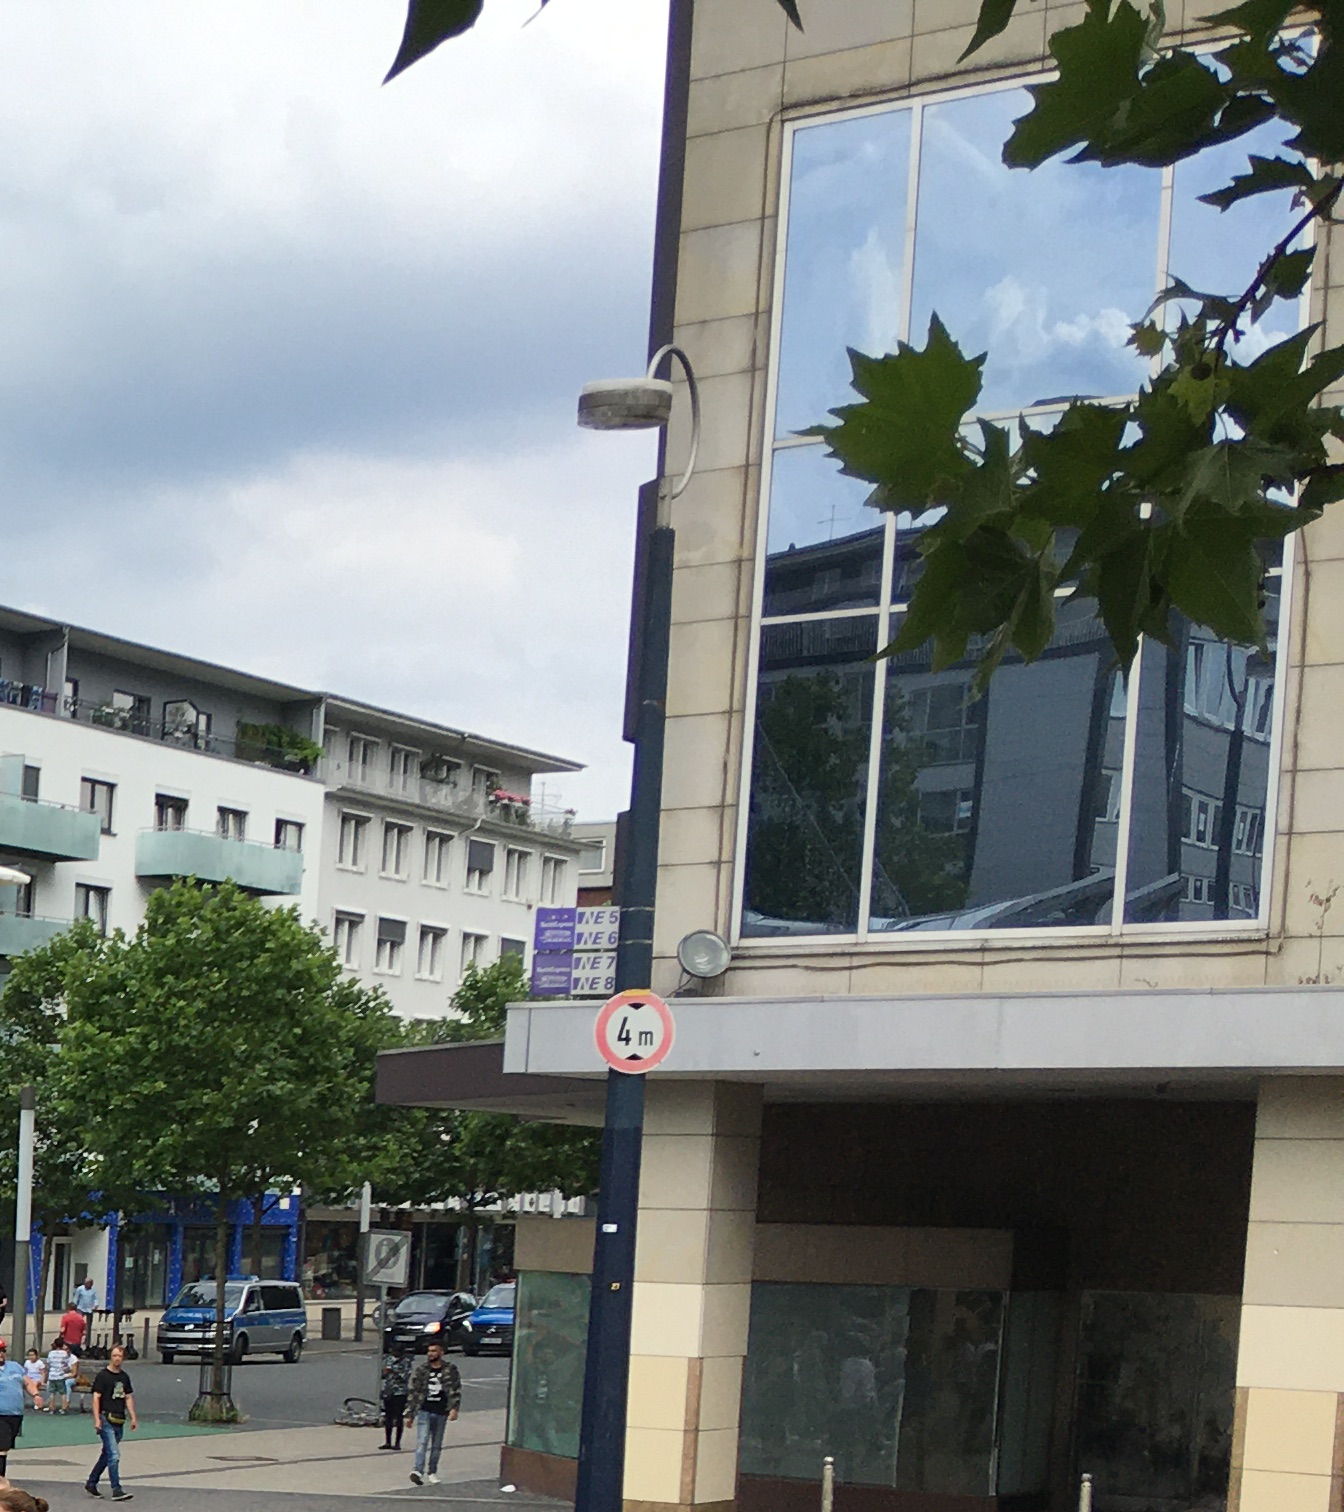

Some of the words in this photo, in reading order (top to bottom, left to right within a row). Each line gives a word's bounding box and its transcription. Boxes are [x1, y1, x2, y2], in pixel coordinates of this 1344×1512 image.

[609, 911, 619, 924] 5
[607, 931, 618, 945] 6
[606, 956, 616, 970] 7
[603, 976, 615, 990] 8
[617, 1016, 632, 1046] 4
[638, 1029, 654, 1046] m
